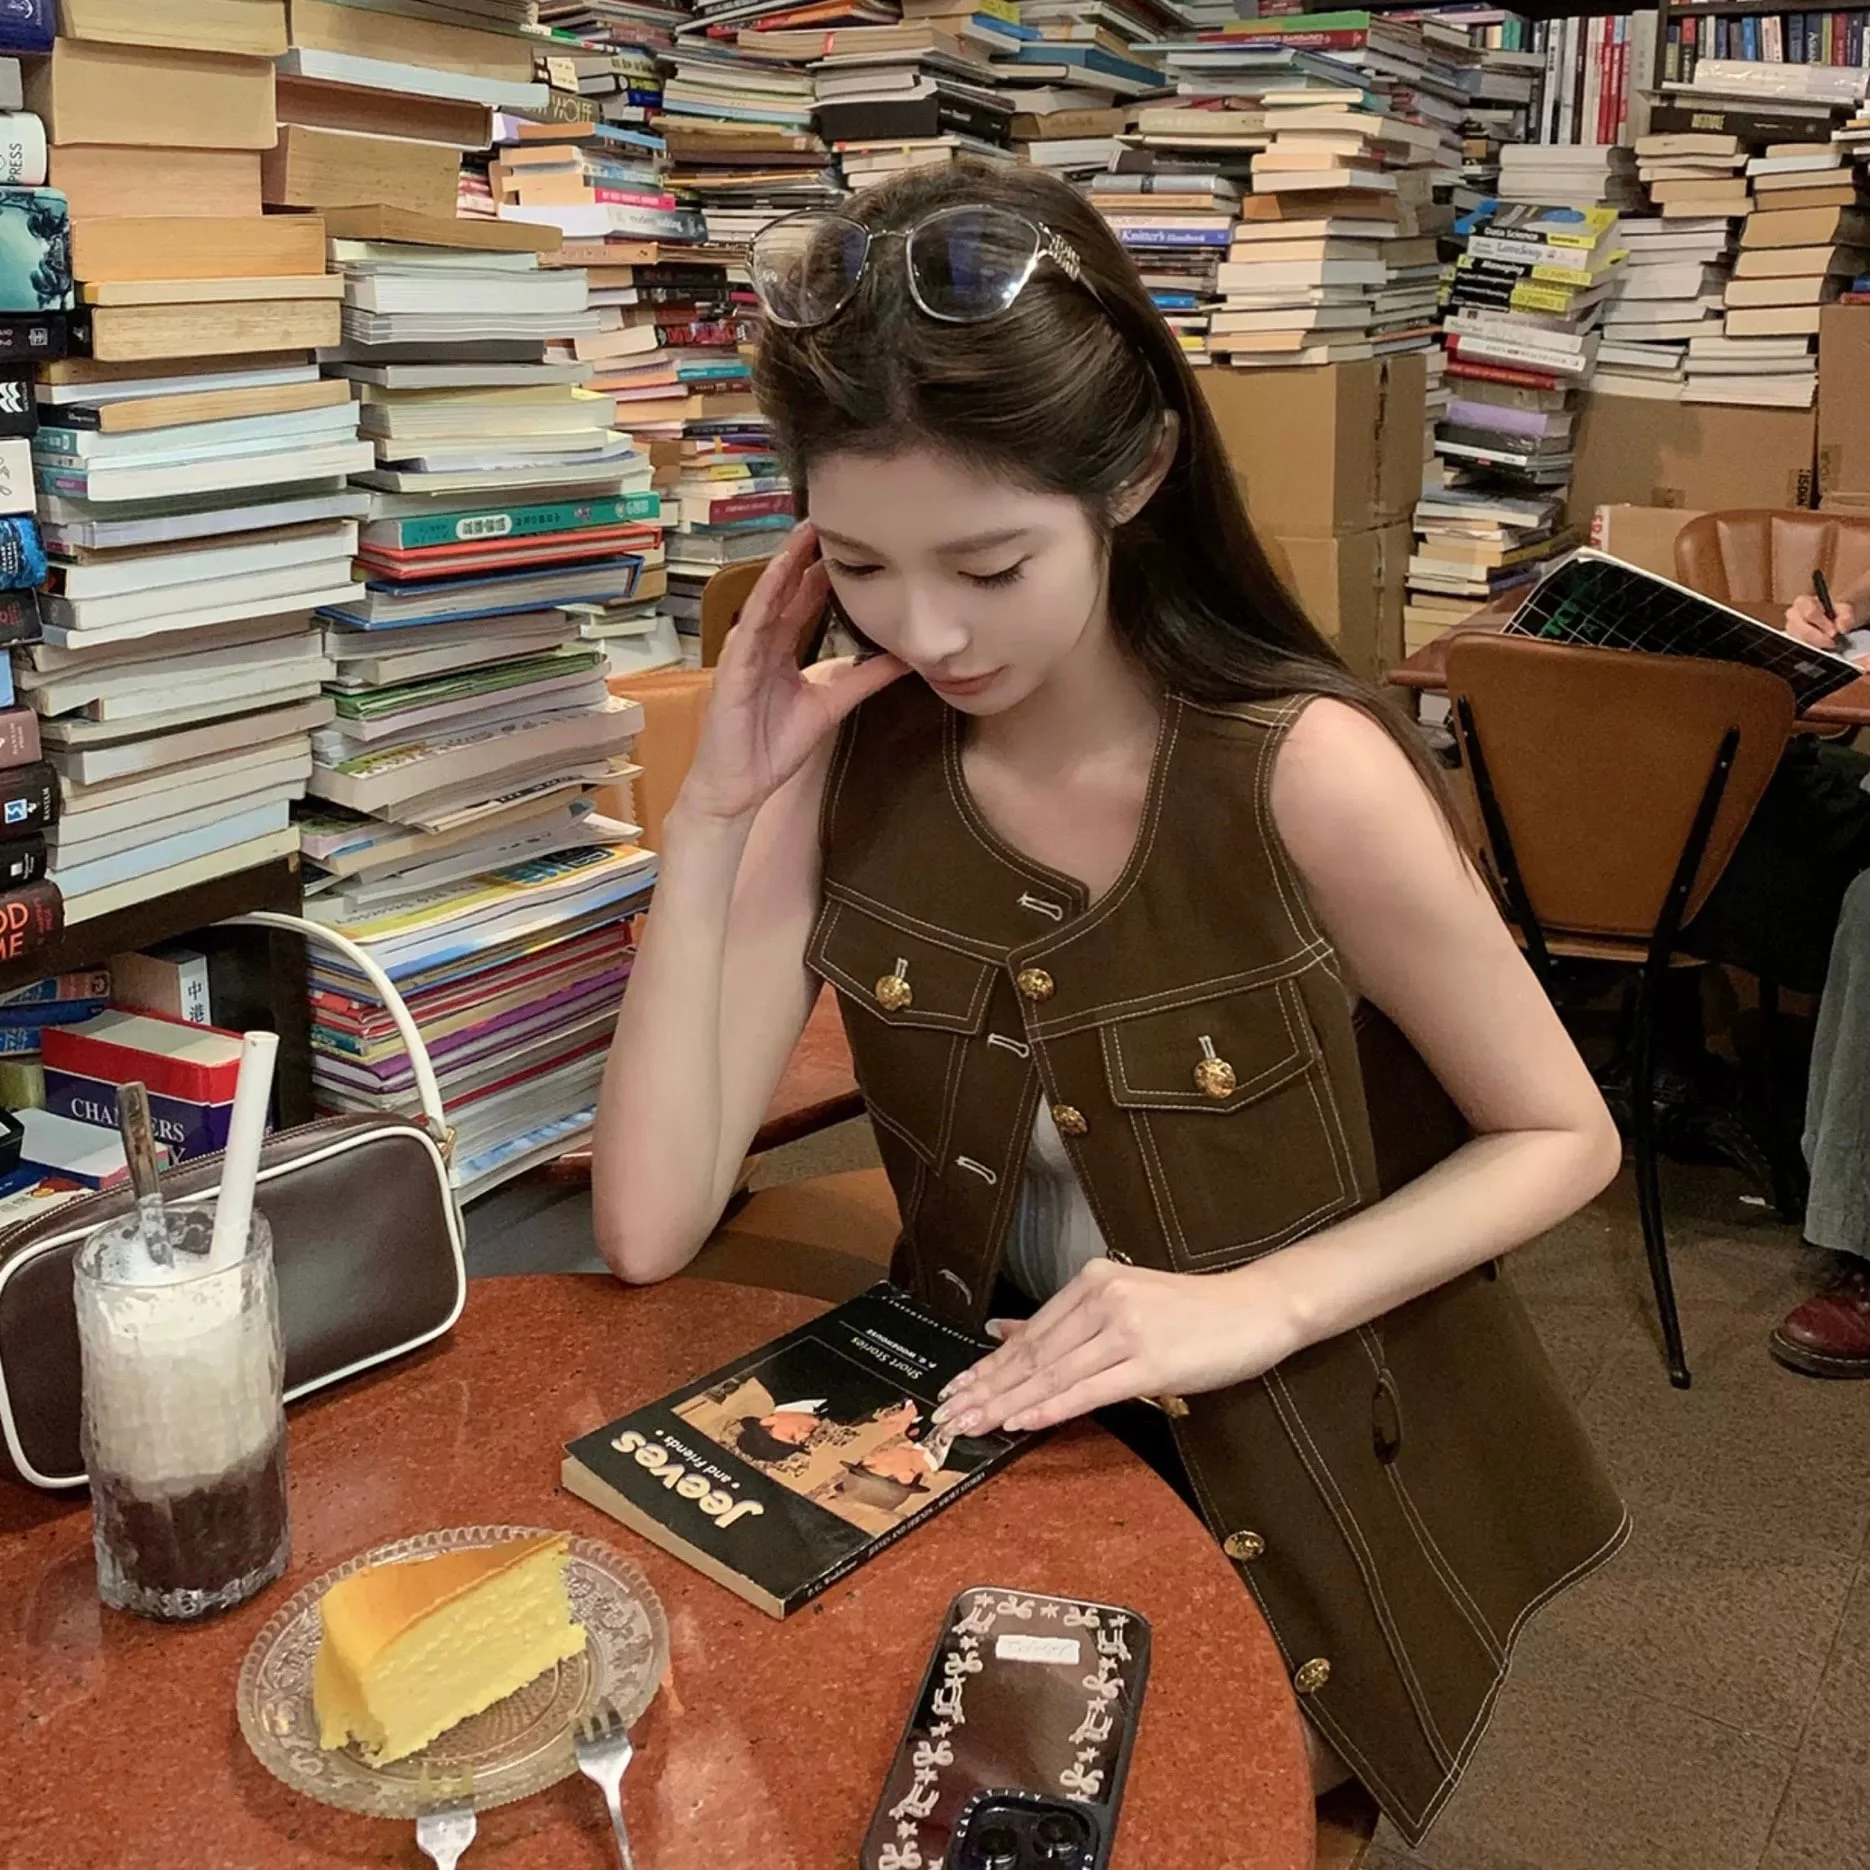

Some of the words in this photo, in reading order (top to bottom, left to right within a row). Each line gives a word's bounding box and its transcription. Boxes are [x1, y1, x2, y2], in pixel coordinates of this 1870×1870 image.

[8, 143, 23, 183] PRESS
[42, 787, 51, 821] BANTAM
[71, 1098, 185, 1142] CHAERS
[851, 1336, 890, 1362] Stories
[889, 1356, 923, 1380] Short
[611, 1430, 765, 1529] Jeeves
[703, 1464, 732, 1484] and
